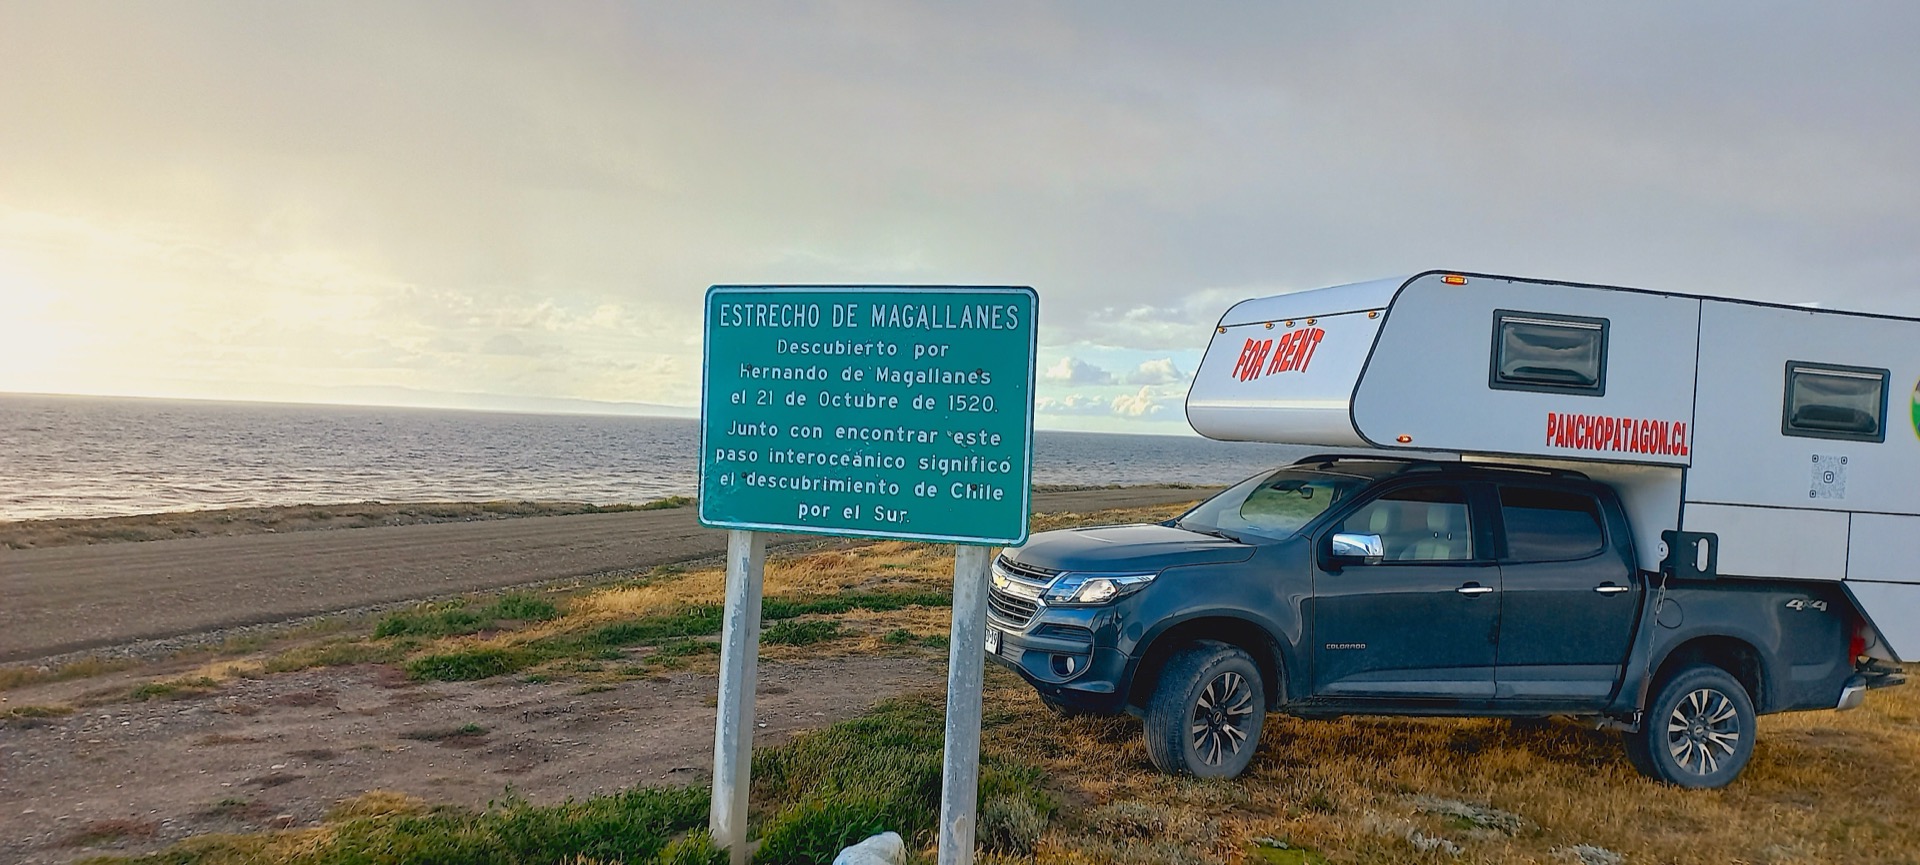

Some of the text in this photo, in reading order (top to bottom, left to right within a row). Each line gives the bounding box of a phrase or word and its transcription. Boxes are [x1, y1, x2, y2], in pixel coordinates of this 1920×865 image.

[719, 303, 1019, 331] ESTRECHO DE MAGALLANES
[777, 338, 949, 360] Descubierto por
[1231, 327, 1326, 383] FOR RENT
[739, 362, 991, 388] Hernando de Magallanes
[731, 388, 999, 413] el 21 de Octubre de 1520.
[727, 420, 1001, 447] Junto con encontrar este
[1545, 412, 1688, 456] PANCHOPATAGON.CL
[715, 447, 1012, 477] paso interoceánico significó
[720, 471, 1005, 502] el descubrimiento de Chile
[798, 502, 911, 525] por el Sur.
